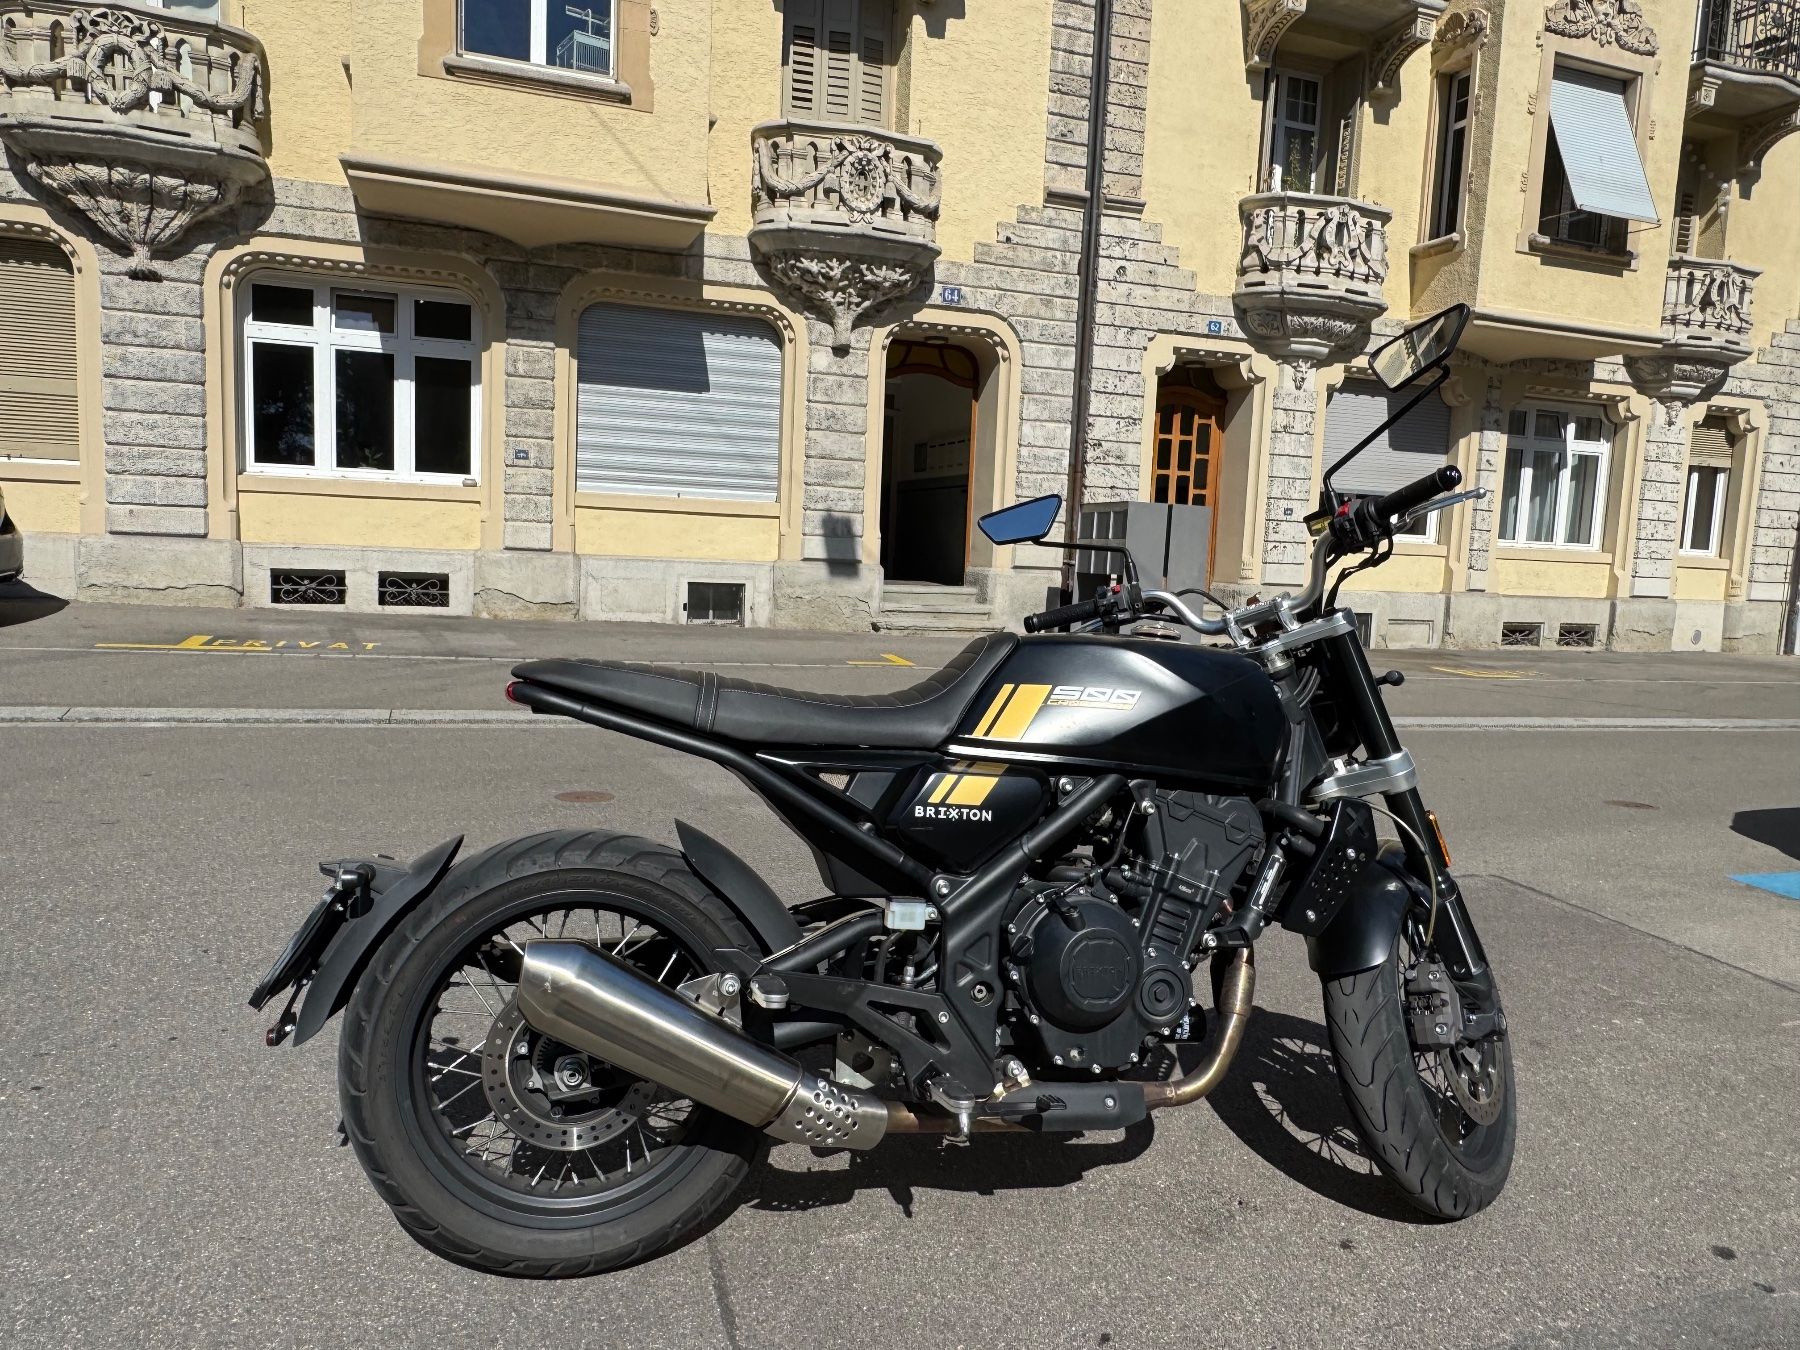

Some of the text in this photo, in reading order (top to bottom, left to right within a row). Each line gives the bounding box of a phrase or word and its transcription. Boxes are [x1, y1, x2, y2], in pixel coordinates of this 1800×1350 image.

[945, 289, 959, 302] 64
[1210, 322, 1220, 332] 62
[211, 639, 382, 650] PRIVAT
[1049, 685, 1142, 703] 500
[914, 805, 992, 822] BRIXTON
